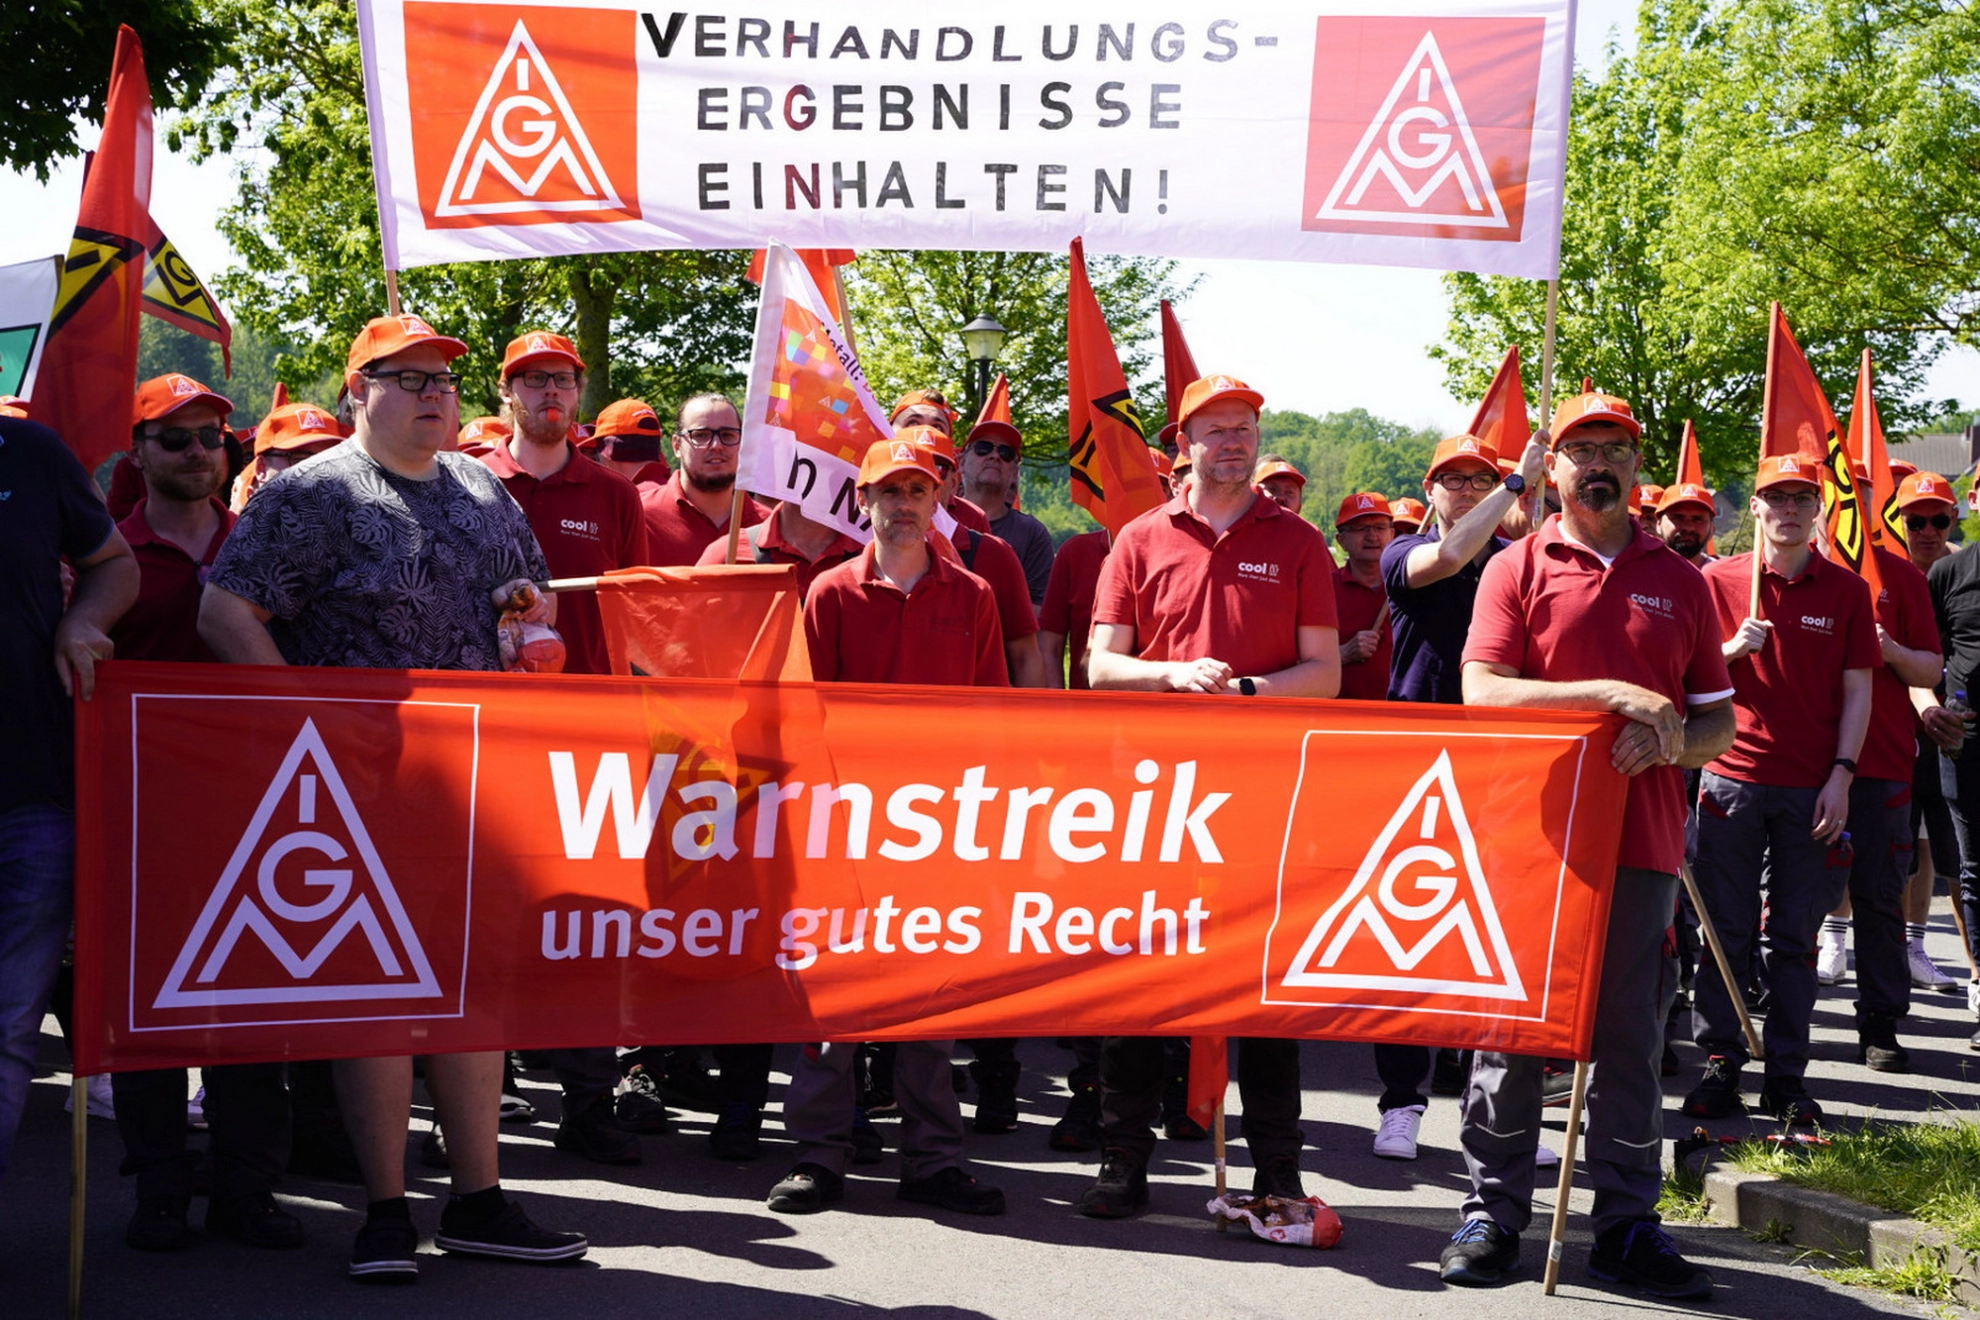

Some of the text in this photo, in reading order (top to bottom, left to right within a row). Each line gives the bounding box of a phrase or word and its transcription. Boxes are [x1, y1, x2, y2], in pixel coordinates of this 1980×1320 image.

[641, 12, 1279, 62] VERHANDLUNGS-
[697, 81, 1182, 131] ERGEBNISSE
[697, 160, 1169, 215] EINHALTEN!
[561, 519, 588, 532] cool
[1238, 562, 1267, 575] cool
[1630, 593, 1660, 609] cool
[1801, 615, 1826, 628] cool
[547, 751, 1233, 863] Warnstreik
[541, 890, 1211, 970] unser gutes Recht
